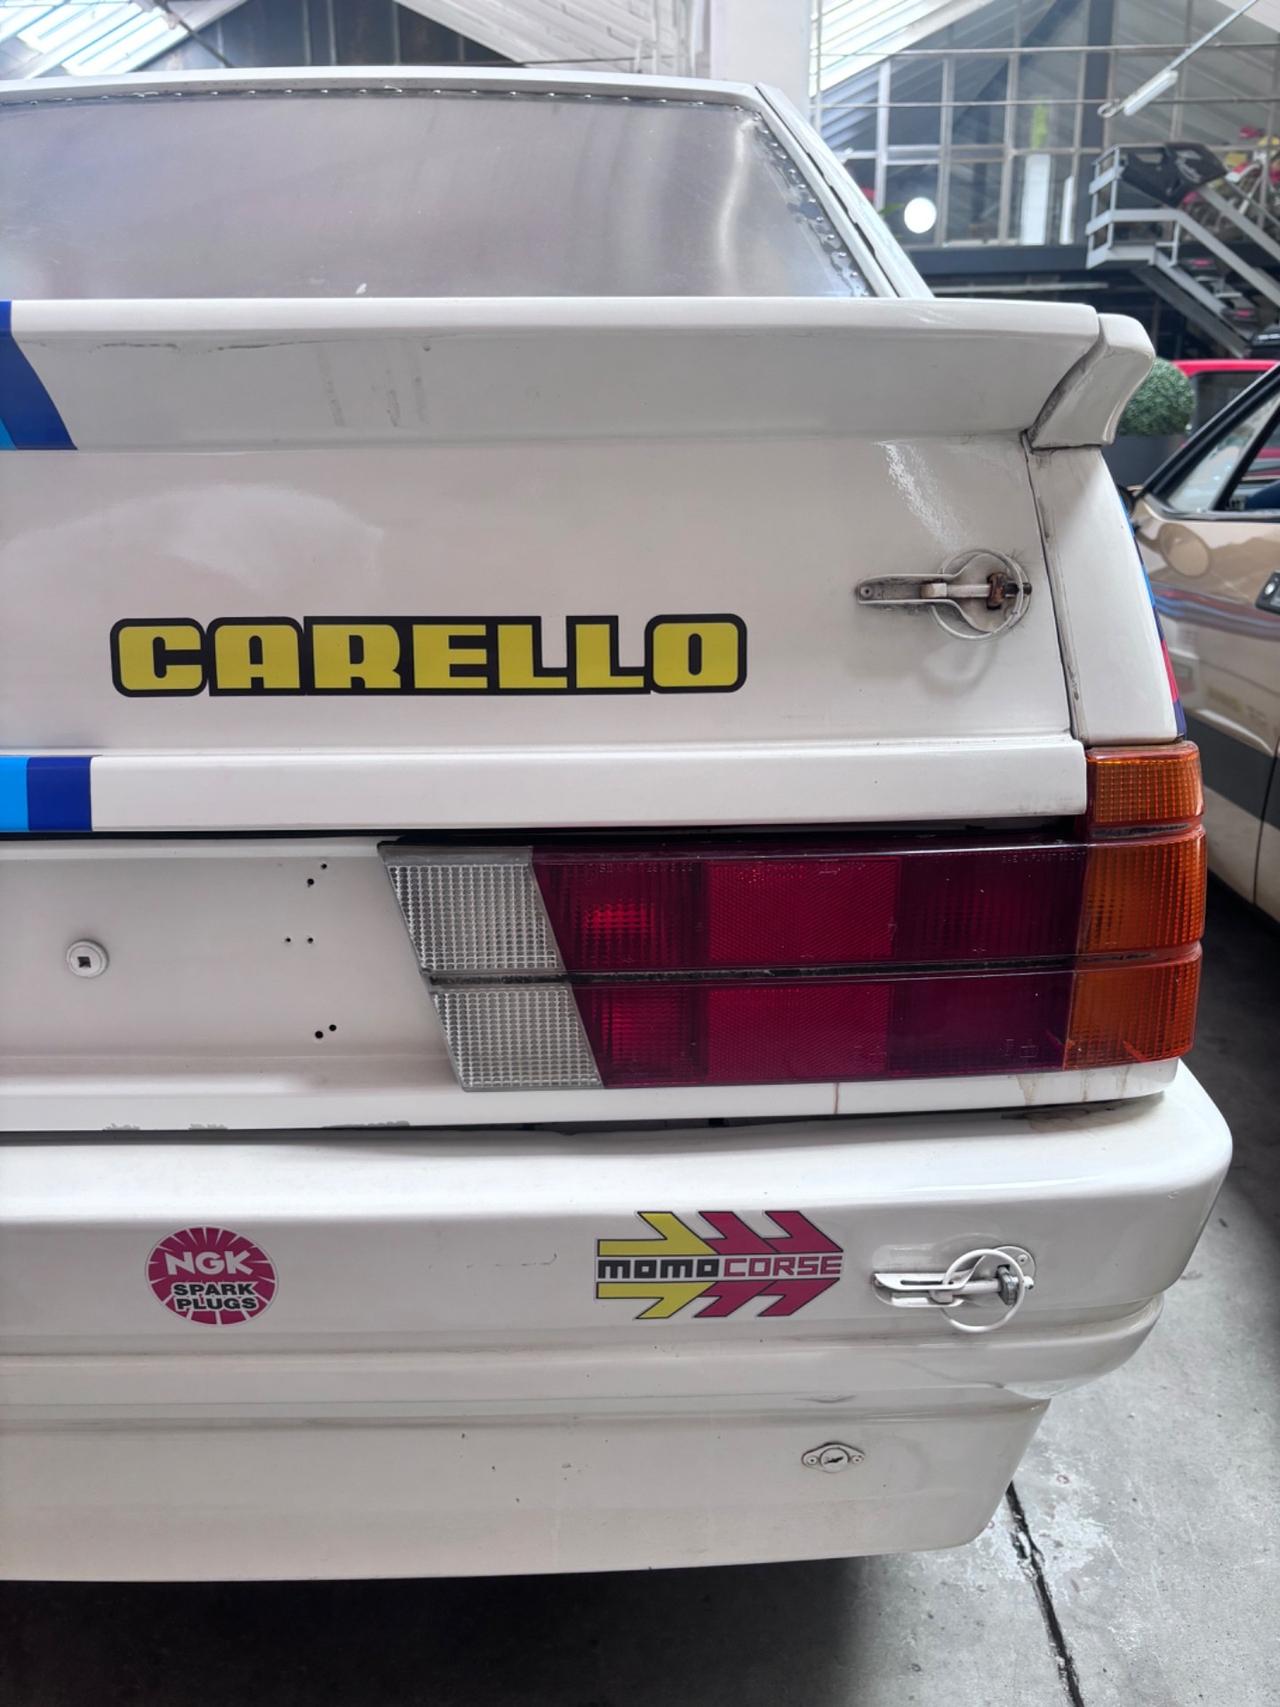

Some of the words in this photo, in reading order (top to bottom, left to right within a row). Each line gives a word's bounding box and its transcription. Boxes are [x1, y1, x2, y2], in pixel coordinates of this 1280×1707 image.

[110, 614, 748, 697] CARELLO
[164, 1250, 253, 1275] NGK
[723, 1255, 843, 1277] CORSE
[173, 1283, 256, 1296] SPARK
[175, 1297, 257, 1310] PLUGS
